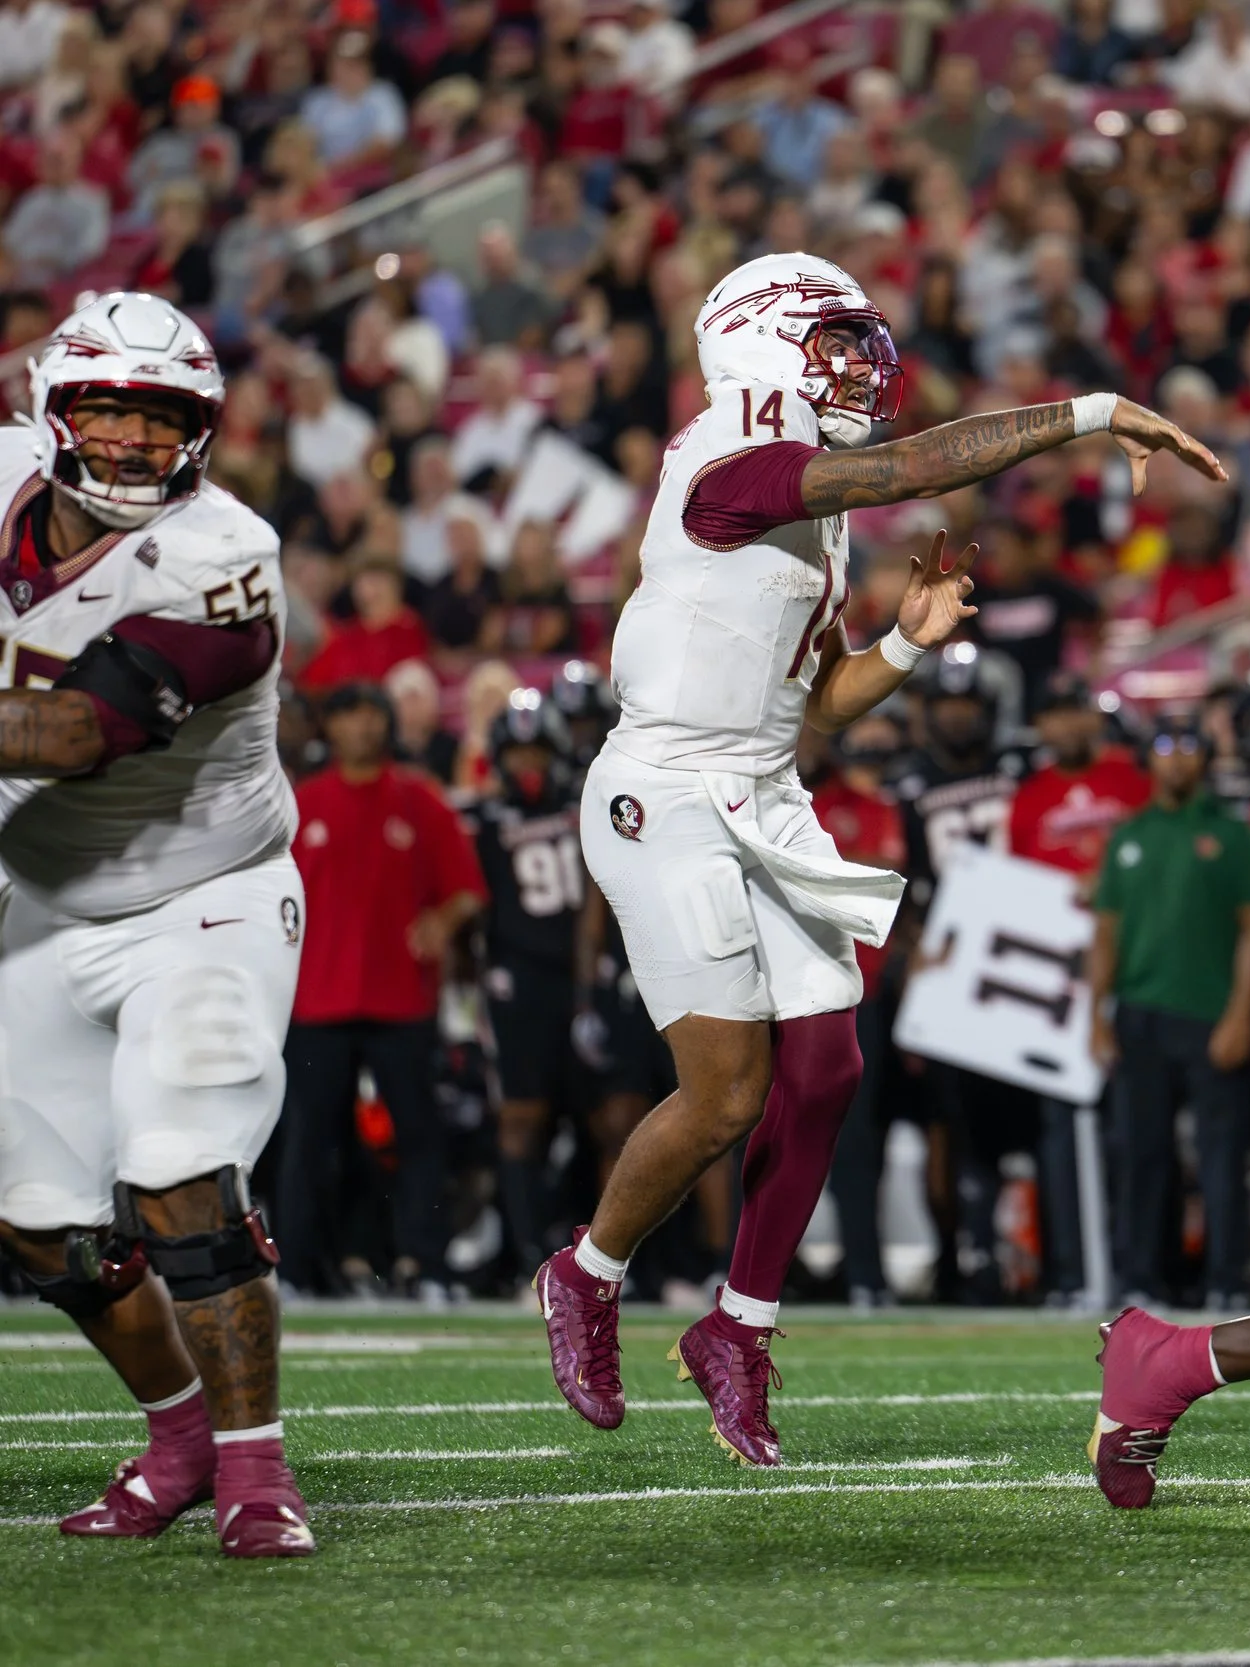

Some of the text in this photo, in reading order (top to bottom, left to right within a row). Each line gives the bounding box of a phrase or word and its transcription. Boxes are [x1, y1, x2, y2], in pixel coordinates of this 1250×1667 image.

[741, 388, 785, 440] 14
[202, 563, 270, 626] 55
[512, 836, 584, 915] 91
